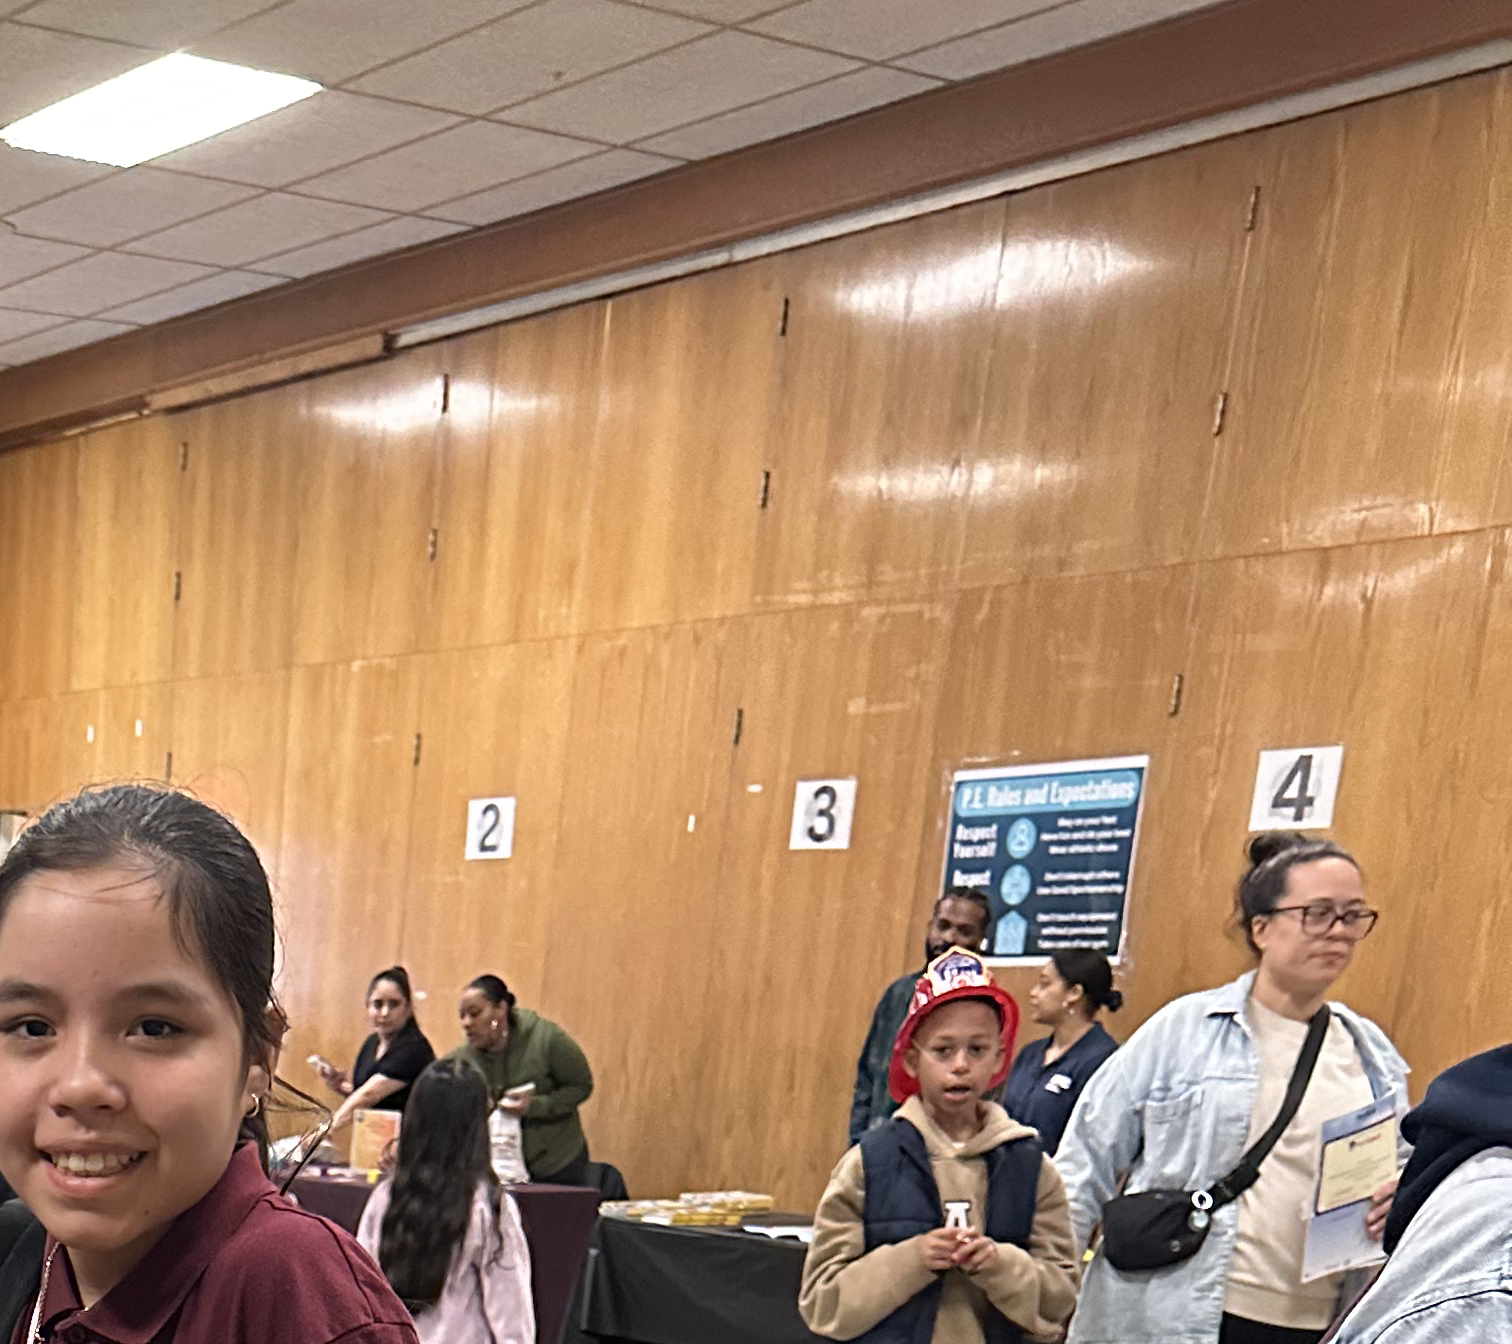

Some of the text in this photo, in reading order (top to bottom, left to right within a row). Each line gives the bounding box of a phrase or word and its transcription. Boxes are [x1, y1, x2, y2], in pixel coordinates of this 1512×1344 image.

[806, 785, 837, 843] 3
[1024, 782, 1048, 805] and
[1271, 754, 1315, 822] 4
[479, 803, 501, 852] 2
